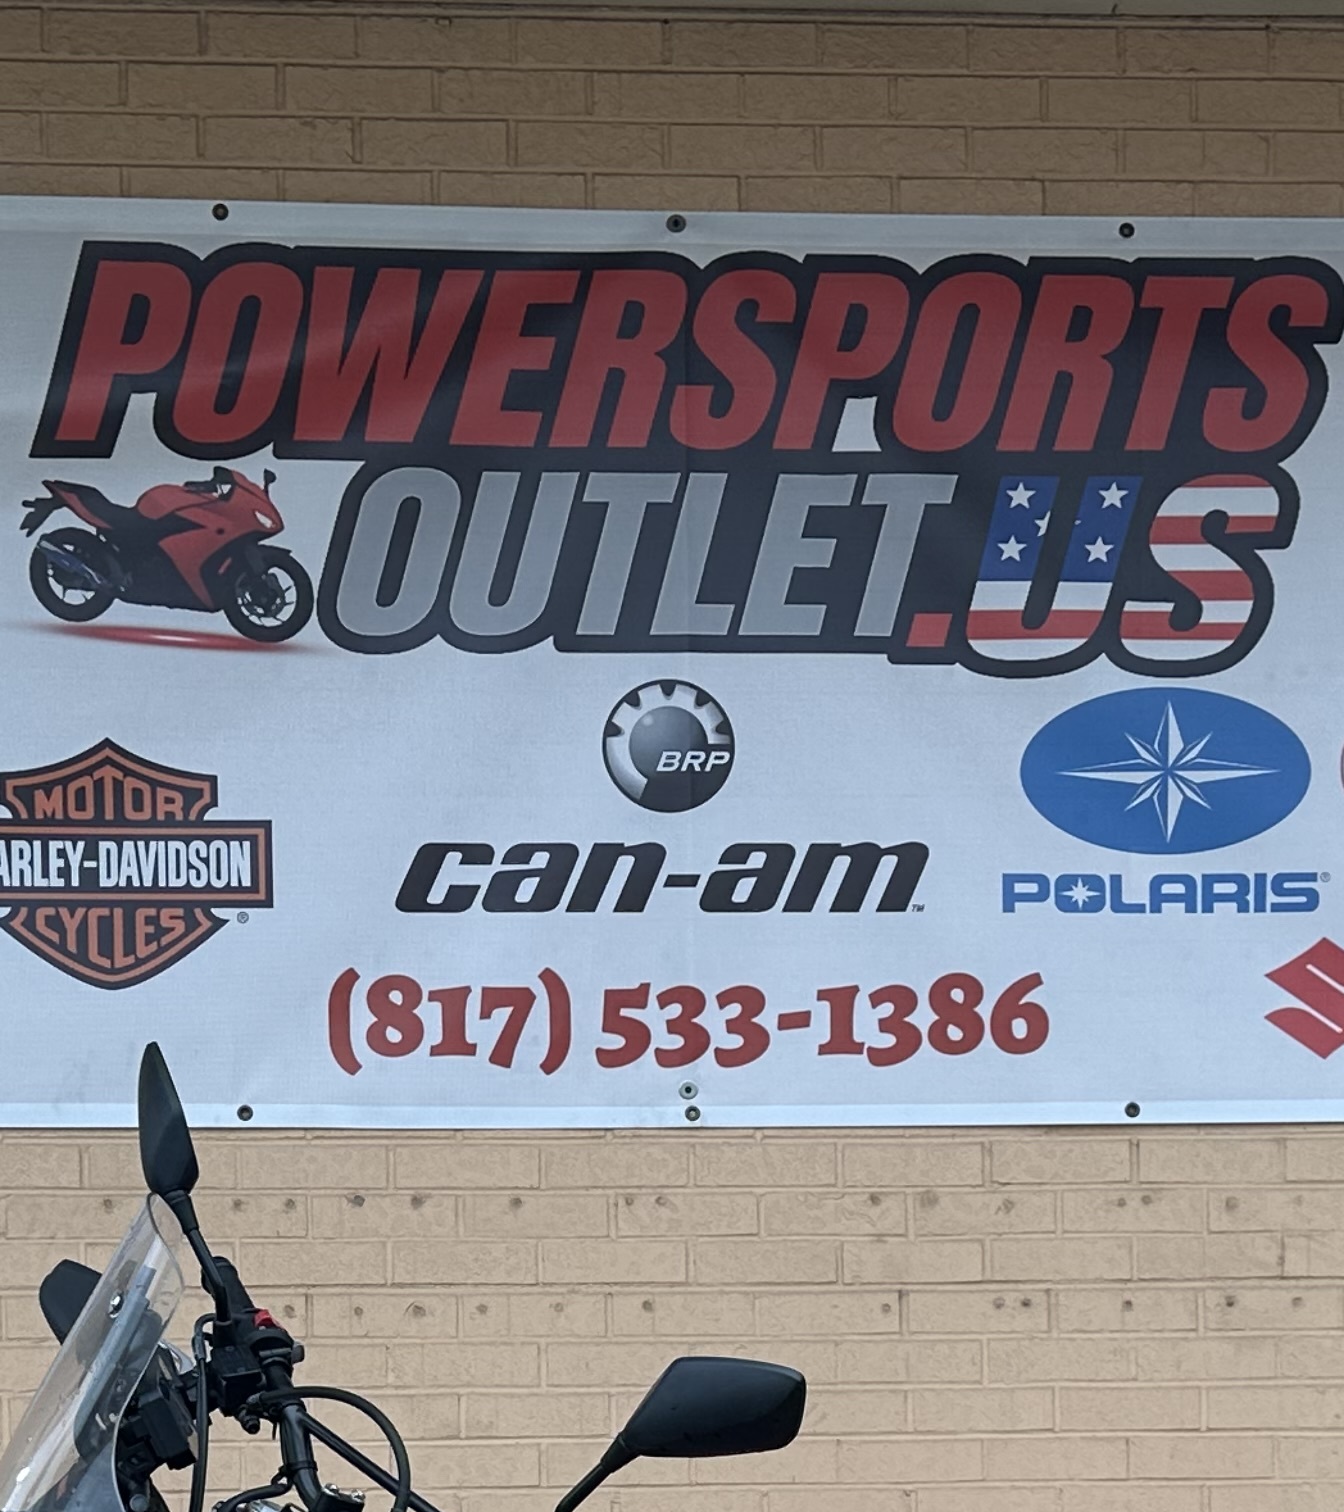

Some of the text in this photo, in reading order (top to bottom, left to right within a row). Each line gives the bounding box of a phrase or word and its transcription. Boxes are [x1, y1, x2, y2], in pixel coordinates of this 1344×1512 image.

[53, 257, 1330, 456] POWERSPORTS
[330, 462, 1279, 660] OUTLET.US
[33, 764, 184, 821] MOTOR
[656, 751, 730, 772] BRP
[395, 842, 930, 913] can-am
[1001, 872, 1320, 914] POLARIS
[35, 906, 186, 968] CYCLES
[328, 967, 1050, 1076] (817) 533-1386
